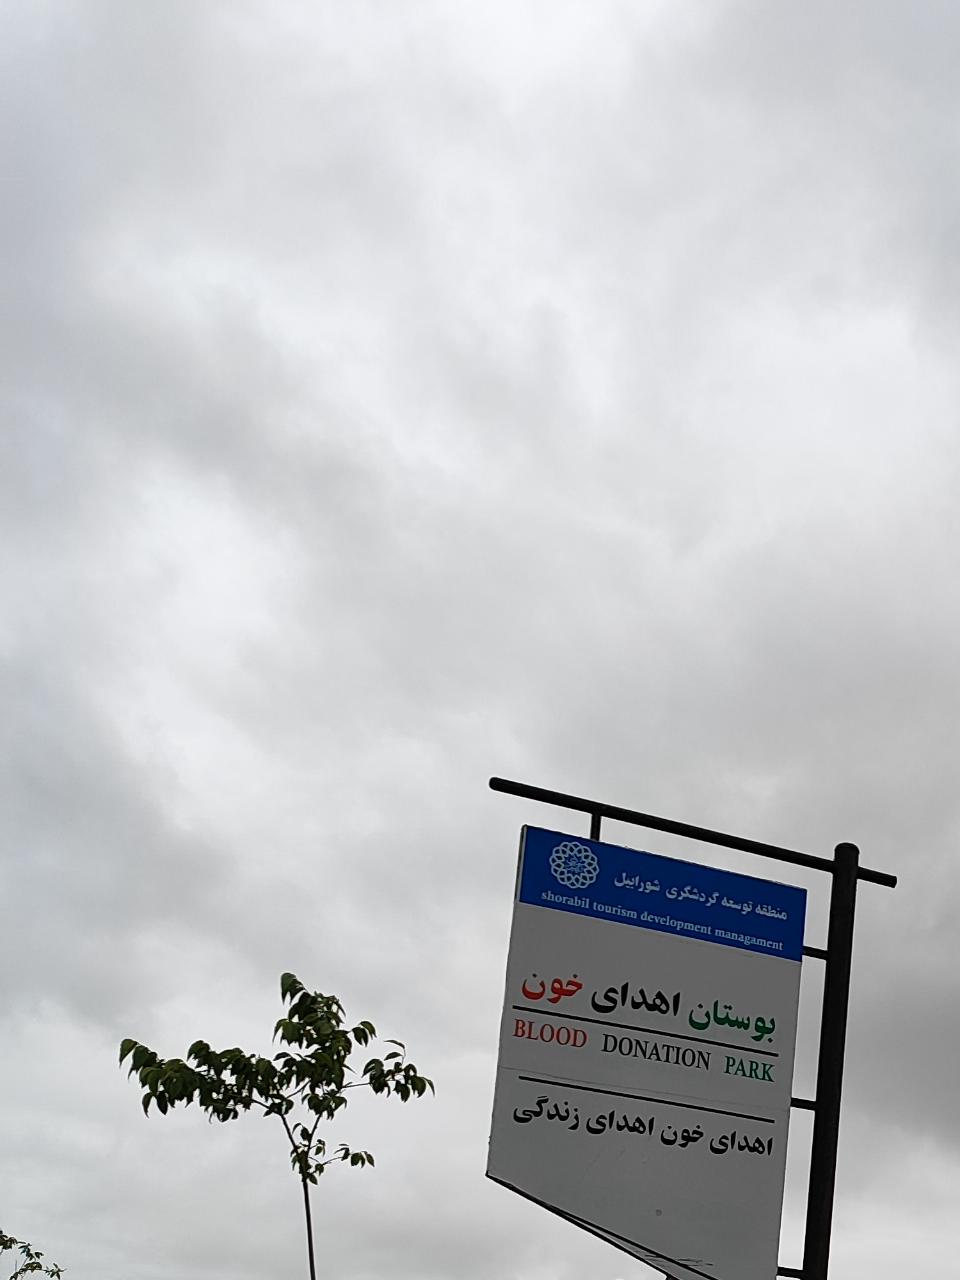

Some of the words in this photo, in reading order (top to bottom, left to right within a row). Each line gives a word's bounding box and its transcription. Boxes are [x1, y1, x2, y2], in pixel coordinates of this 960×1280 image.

[614, 872, 660, 892] شورابیل
[666, 886, 720, 907] گردشگری
[721, 895, 753, 913] توسعه
[541, 890, 590, 909] shorabil
[593, 901, 637, 919] tourism
[640, 910, 712, 935] development
[755, 904, 788, 921] منطقه
[522, 974, 583, 1003] خون
[591, 982, 680, 1016] اهدای
[688, 1000, 776, 1043] بوستان
[512, 1019, 587, 1048] BLOOD
[601, 1034, 711, 1070] DONATION
[724, 1056, 775, 1082] PARK
[513, 1096, 579, 1130] زندگی
[586, 1111, 654, 1136] اهدای
[661, 1124, 704, 1148] خون
[710, 1132, 773, 1156] اهدای
